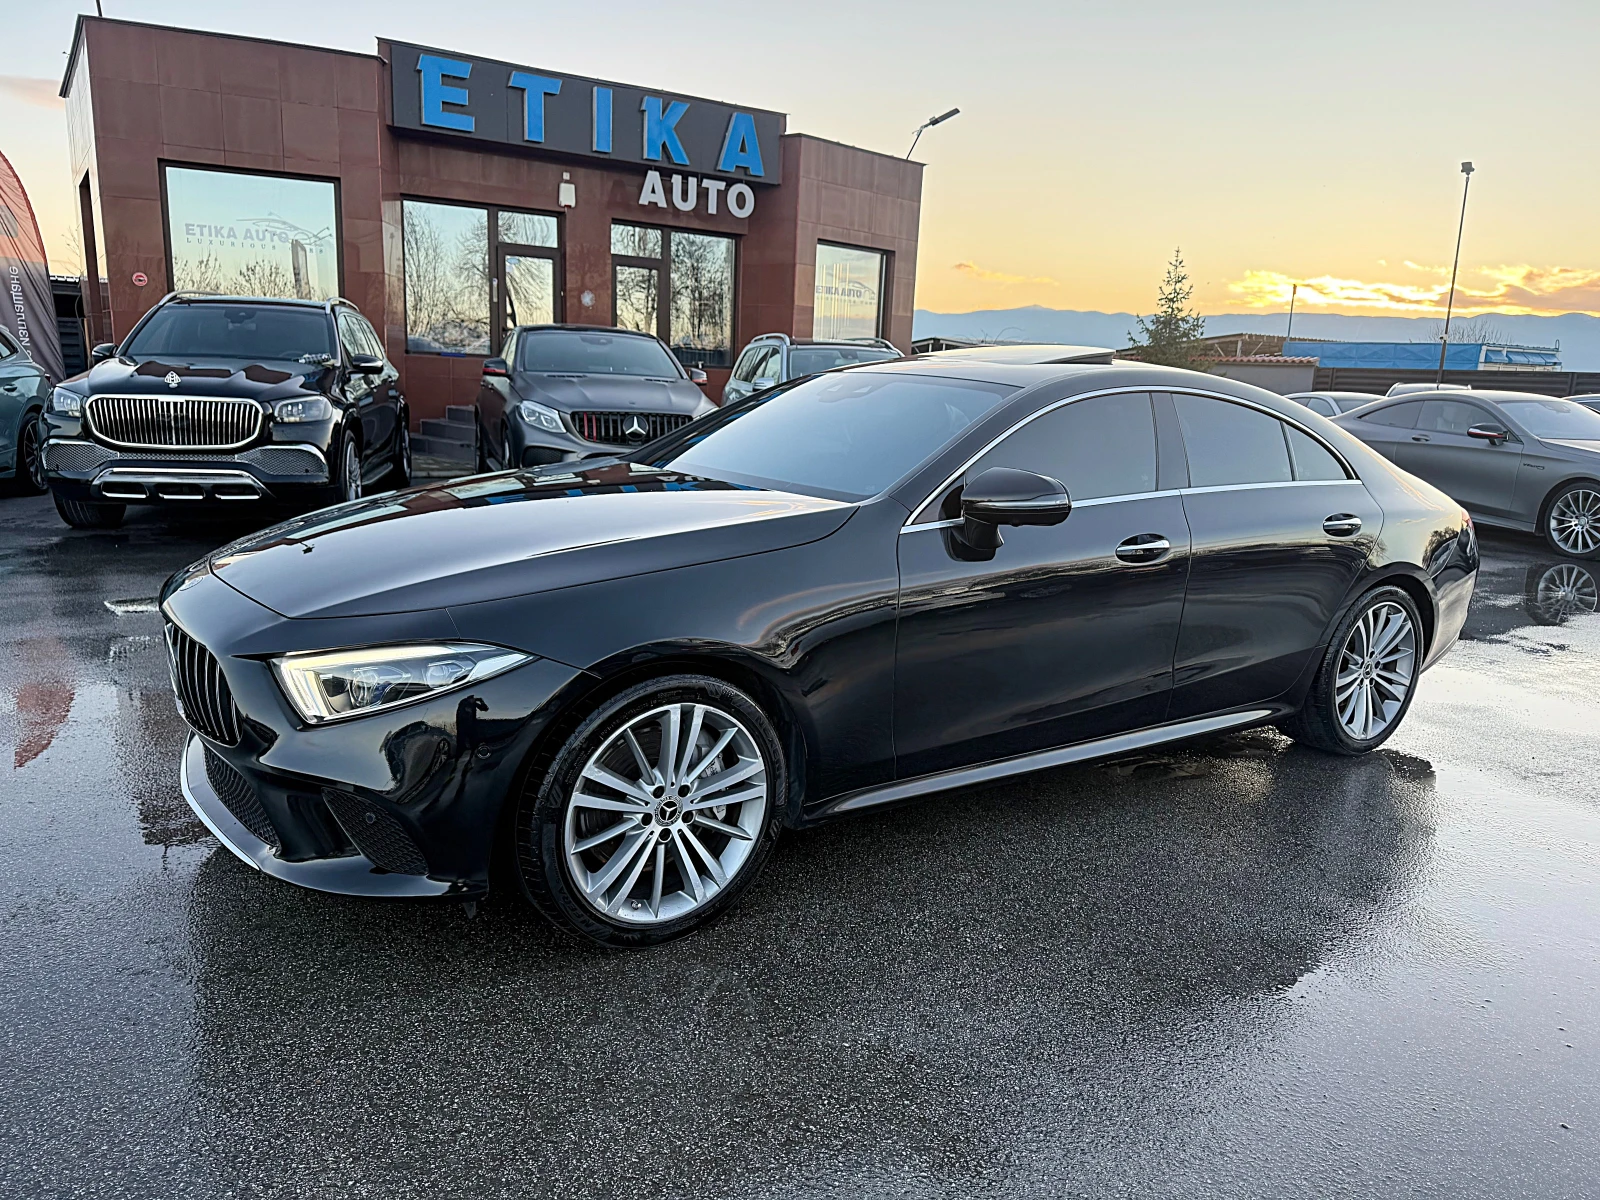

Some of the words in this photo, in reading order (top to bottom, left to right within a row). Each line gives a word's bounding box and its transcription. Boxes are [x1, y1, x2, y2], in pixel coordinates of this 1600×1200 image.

[415, 53, 765, 177] ETIKA
[638, 170, 755, 218] AUTO
[185, 223, 237, 240] ETIKA
[243, 228, 289, 243] AUTO
[186, 237, 276, 250] LUXURIOUS
